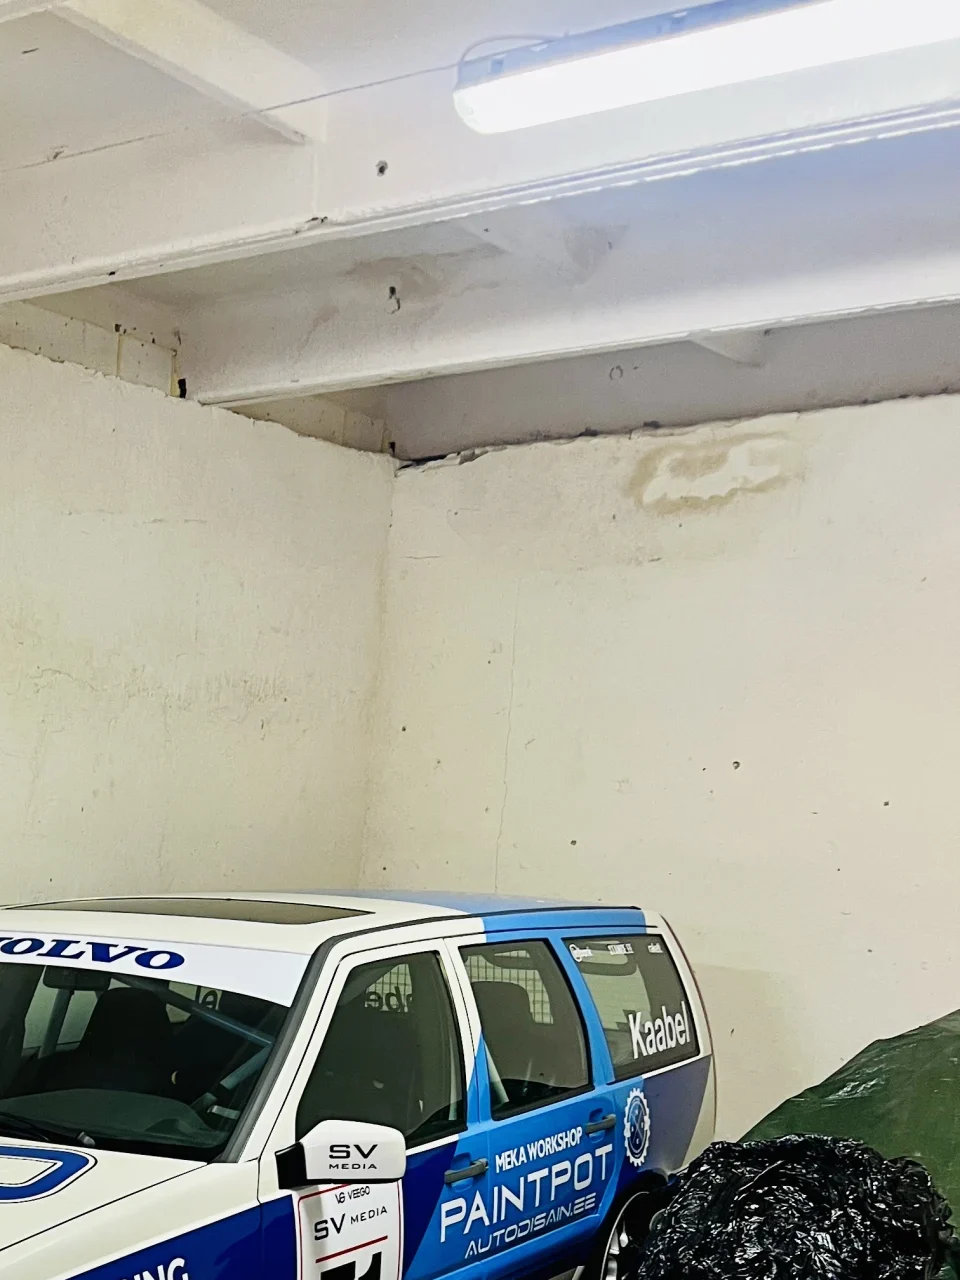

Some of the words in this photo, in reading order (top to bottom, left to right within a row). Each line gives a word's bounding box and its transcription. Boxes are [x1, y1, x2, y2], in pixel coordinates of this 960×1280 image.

[628, 1000, 690, 1059] Kaabel
[329, 1144, 378, 1159] SV
[495, 1146, 527, 1174] MEKA
[527, 1127, 583, 1161] WORKSHOP
[347, 1185, 370, 1200] VEEGO
[440, 1144, 613, 1243] PAINTPOT
[314, 1213, 346, 1241] SV
[350, 1205, 387, 1224] MEDIA
[464, 1192, 596, 1259] AUTODISAIN.EE
